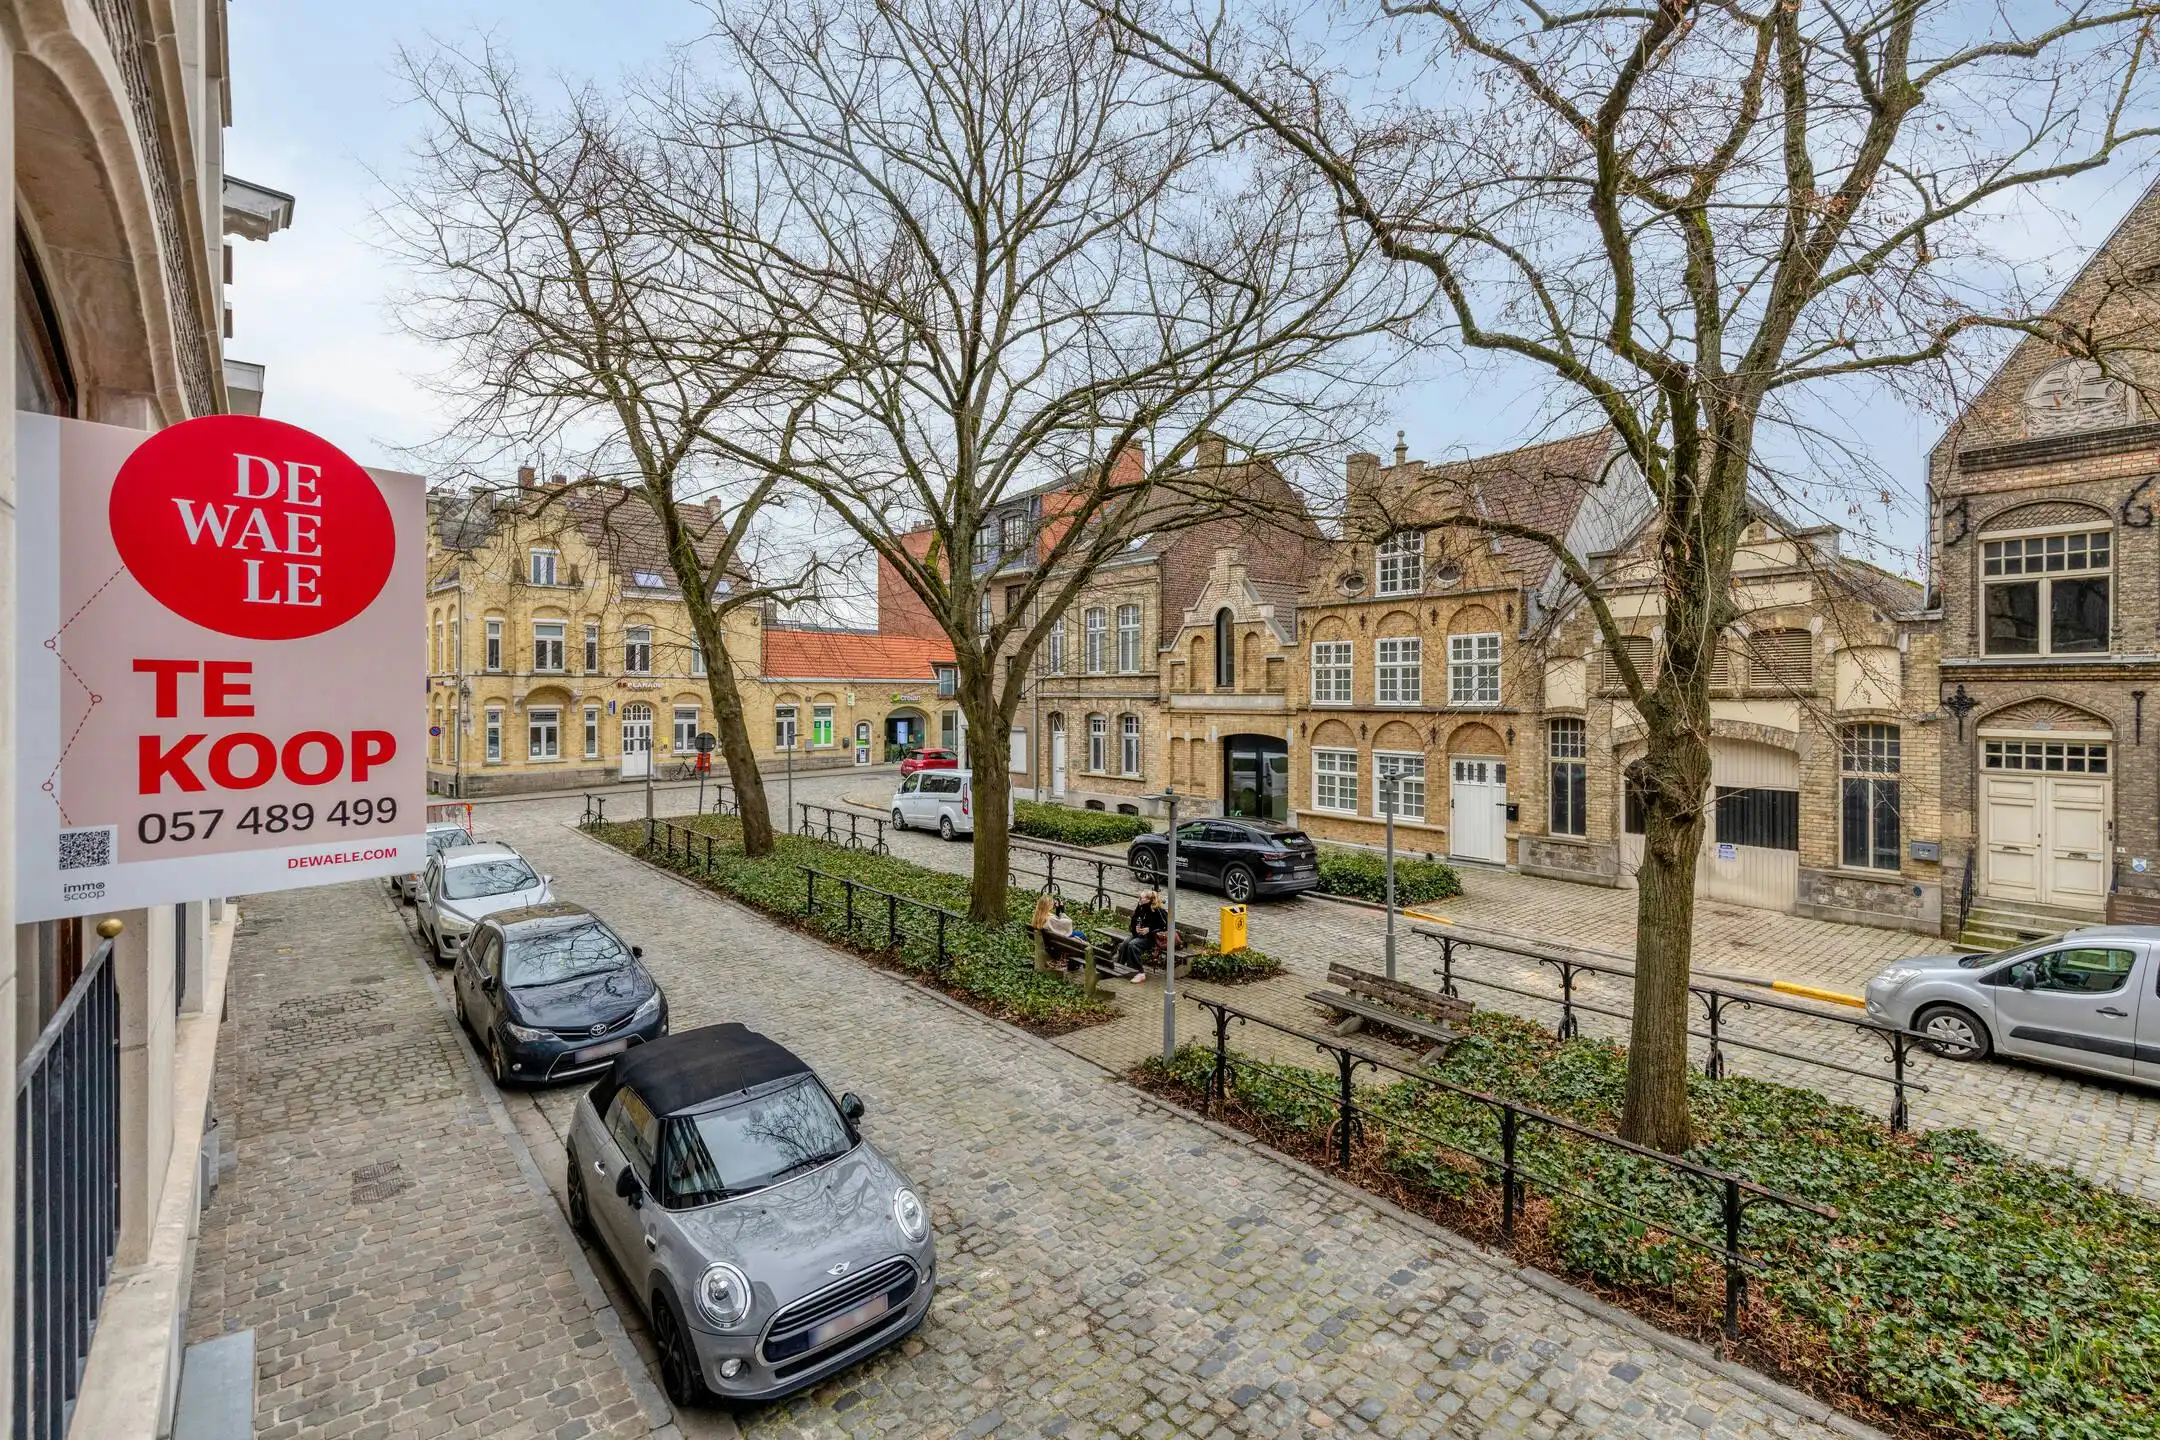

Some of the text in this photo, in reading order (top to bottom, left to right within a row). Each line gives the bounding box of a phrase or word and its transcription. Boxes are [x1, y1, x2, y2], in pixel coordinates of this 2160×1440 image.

[233, 453, 322, 508] DE
[171, 497, 322, 557] WAE
[243, 558, 322, 607] LE
[133, 659, 255, 718] TE
[139, 730, 397, 795] KOOP
[138, 796, 397, 844] 057 489 499
[288, 847, 397, 869] DEWAELE.COM
[64, 890, 105, 901] scoop
